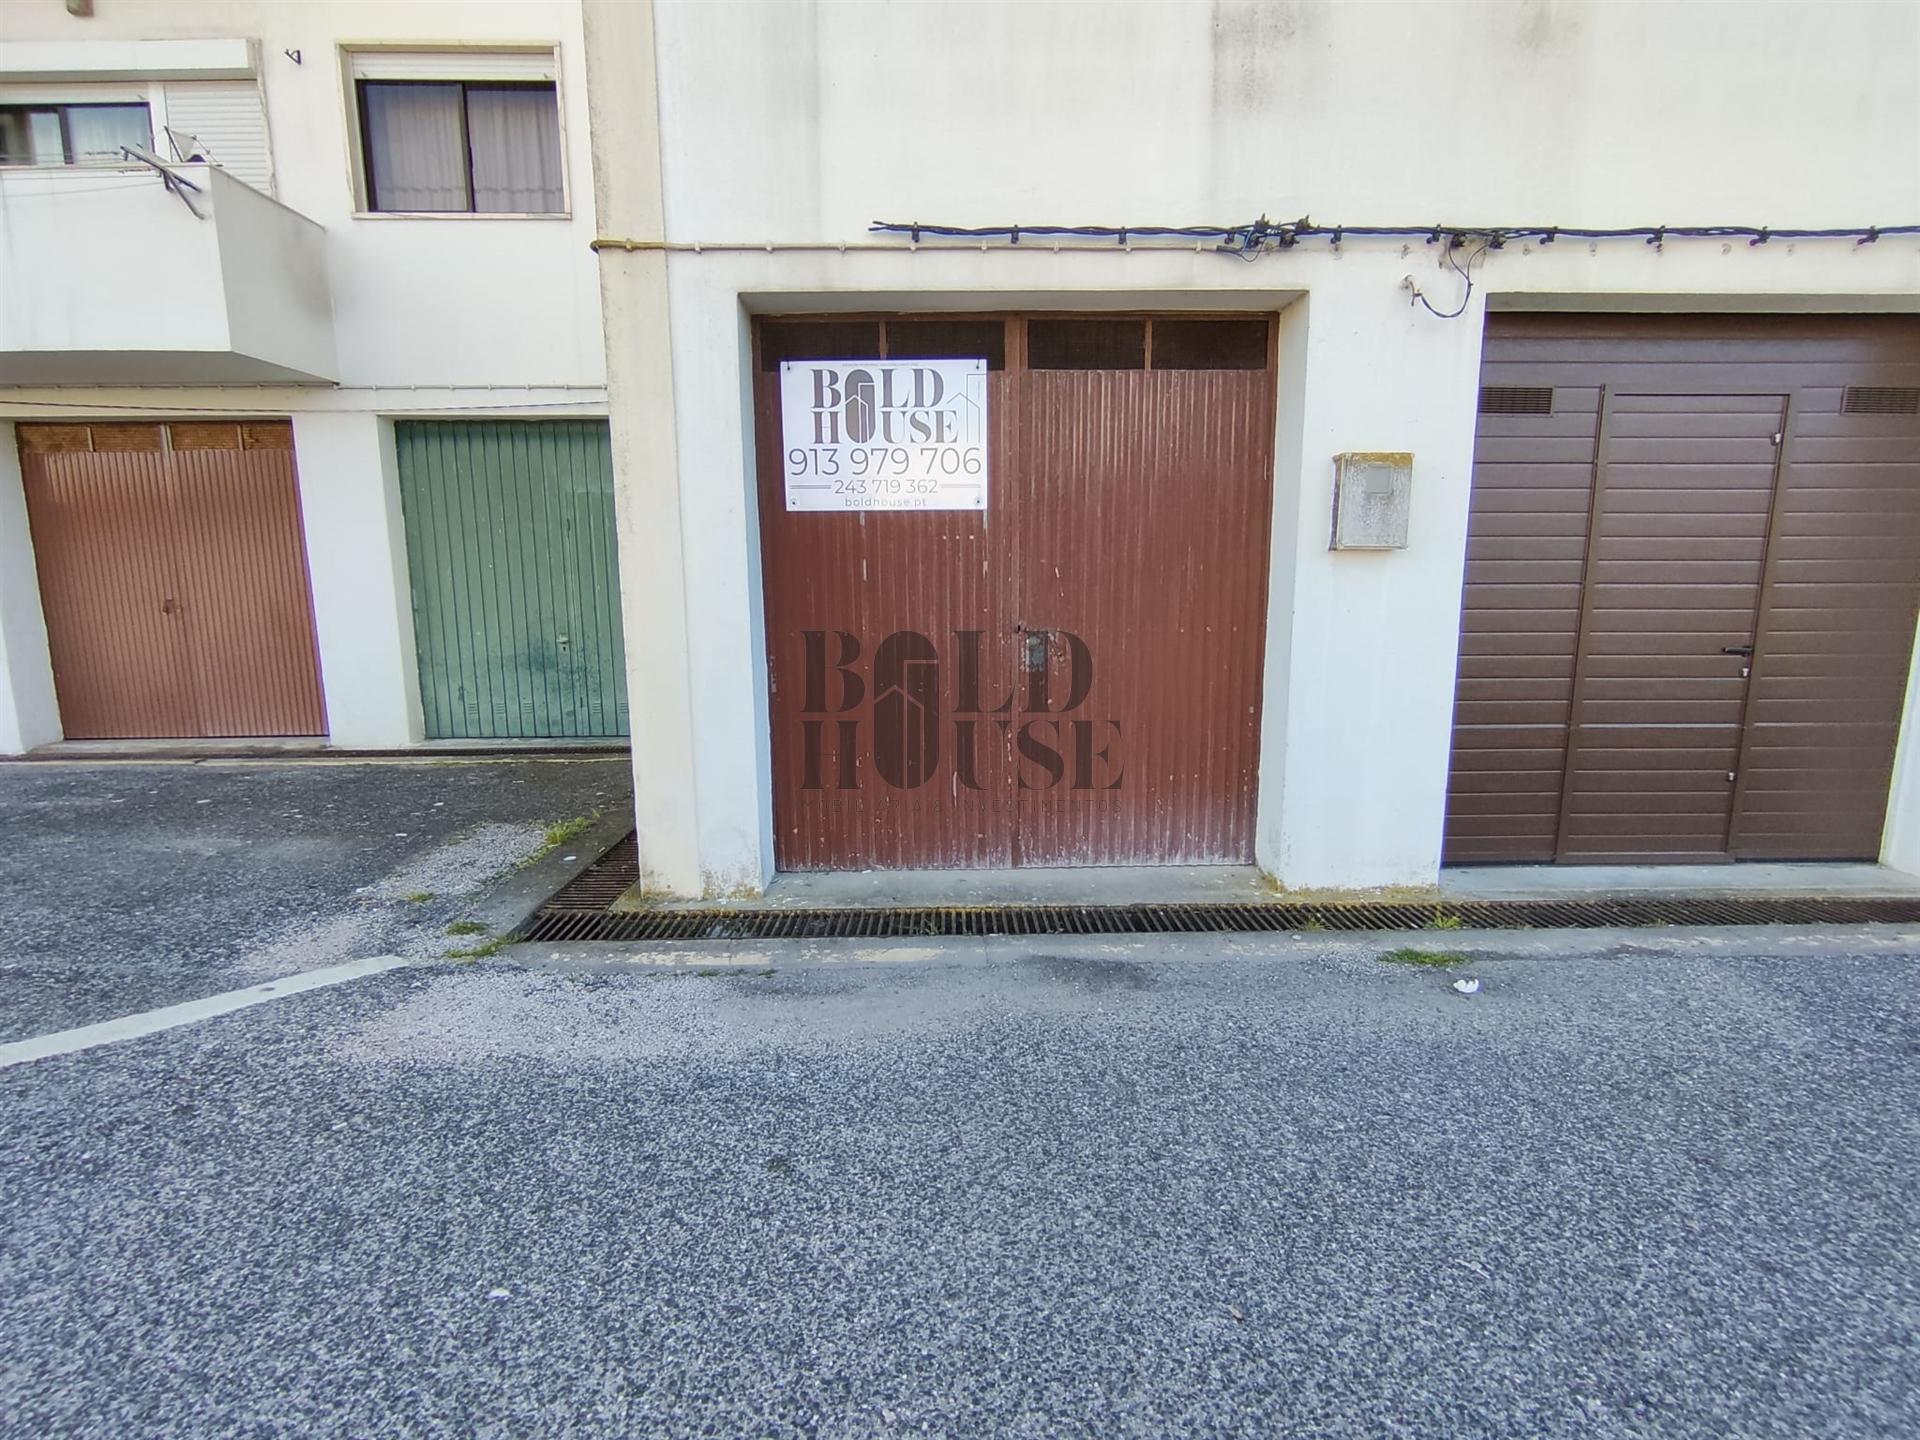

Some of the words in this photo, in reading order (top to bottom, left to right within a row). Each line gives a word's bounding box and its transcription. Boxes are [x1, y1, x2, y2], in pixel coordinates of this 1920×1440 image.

[811, 368, 944, 409] BOLD
[811, 410, 959, 444] HOUSE
[788, 448, 840, 476] 913
[850, 447, 910, 475] 979
[920, 447, 982, 475] 706
[834, 479, 867, 494] 243
[872, 479, 901, 494] 719
[905, 479, 938, 493] 362
[844, 497, 927, 508] boldhousept
